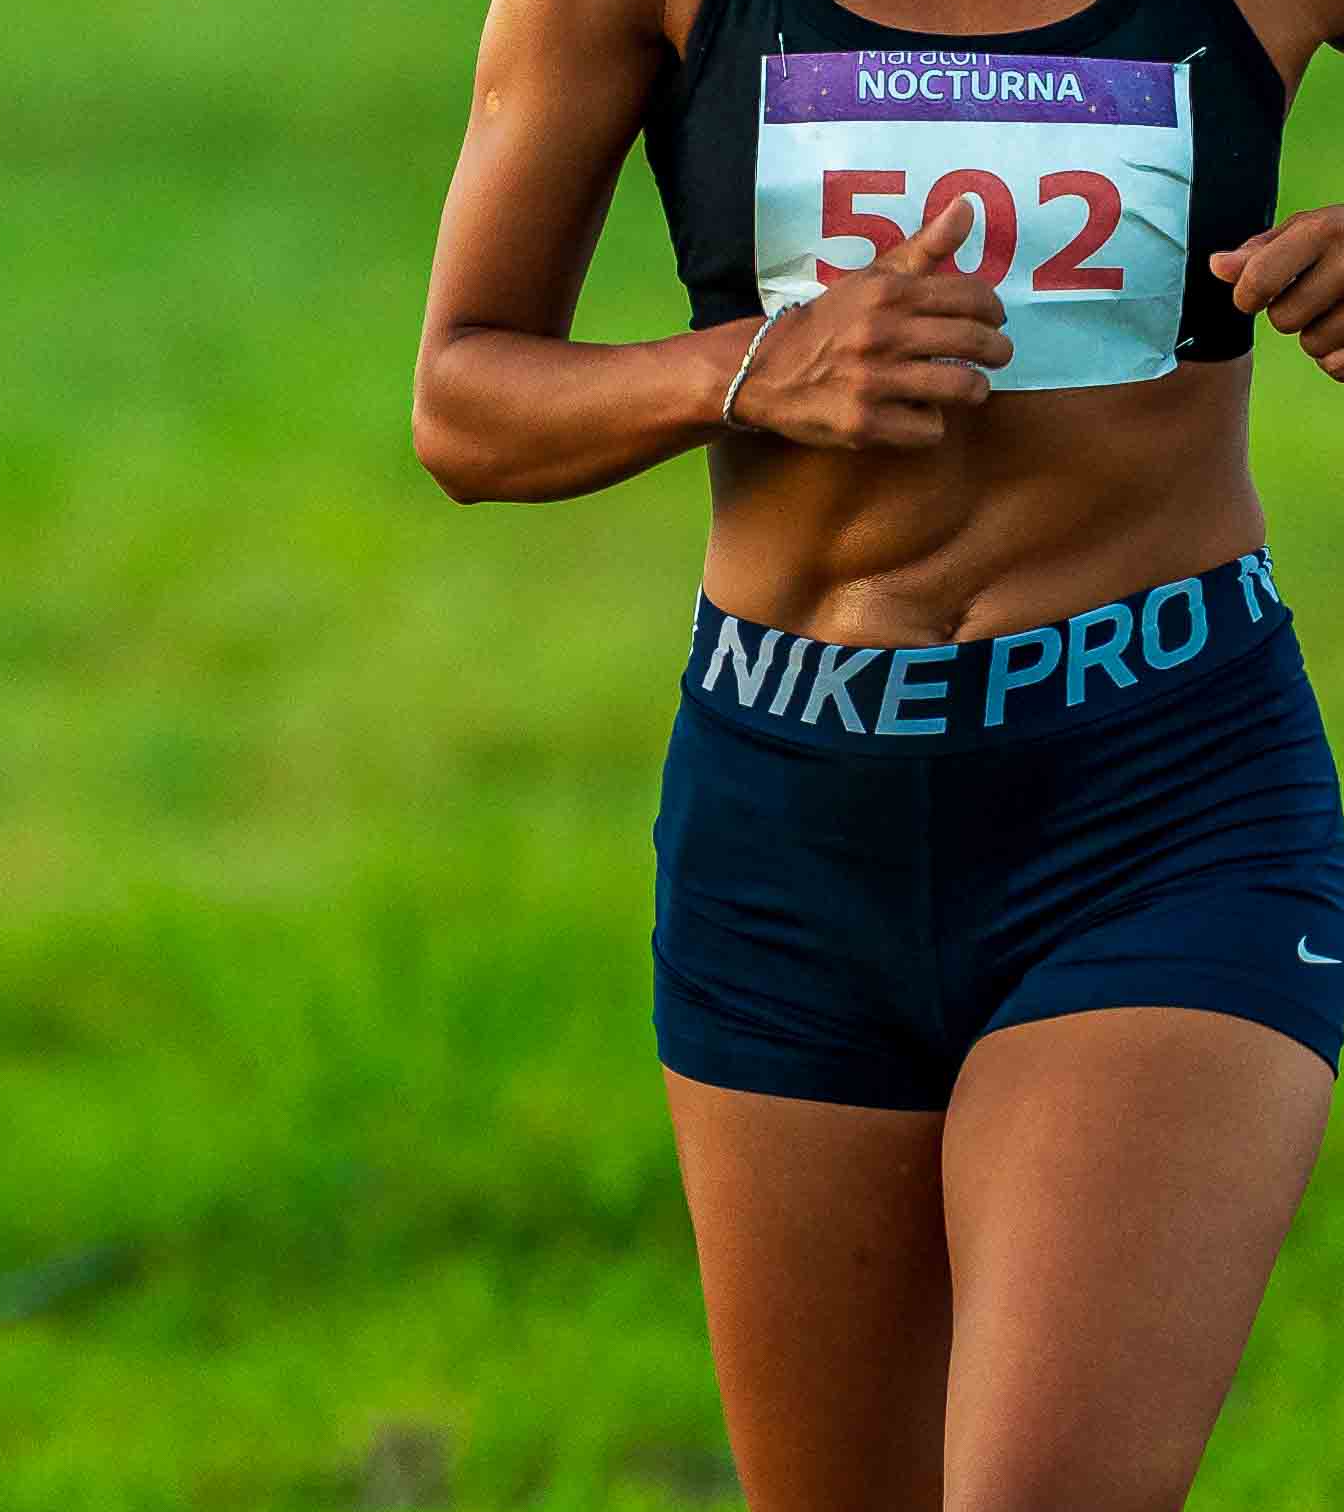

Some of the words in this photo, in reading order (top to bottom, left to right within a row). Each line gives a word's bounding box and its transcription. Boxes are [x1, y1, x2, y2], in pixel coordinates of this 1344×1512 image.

[858, 69, 1085, 103] NOCTURNA
[815, 169, 1125, 292] 502
[702, 615, 958, 735] NIKE
[983, 576, 1209, 727] PRO
